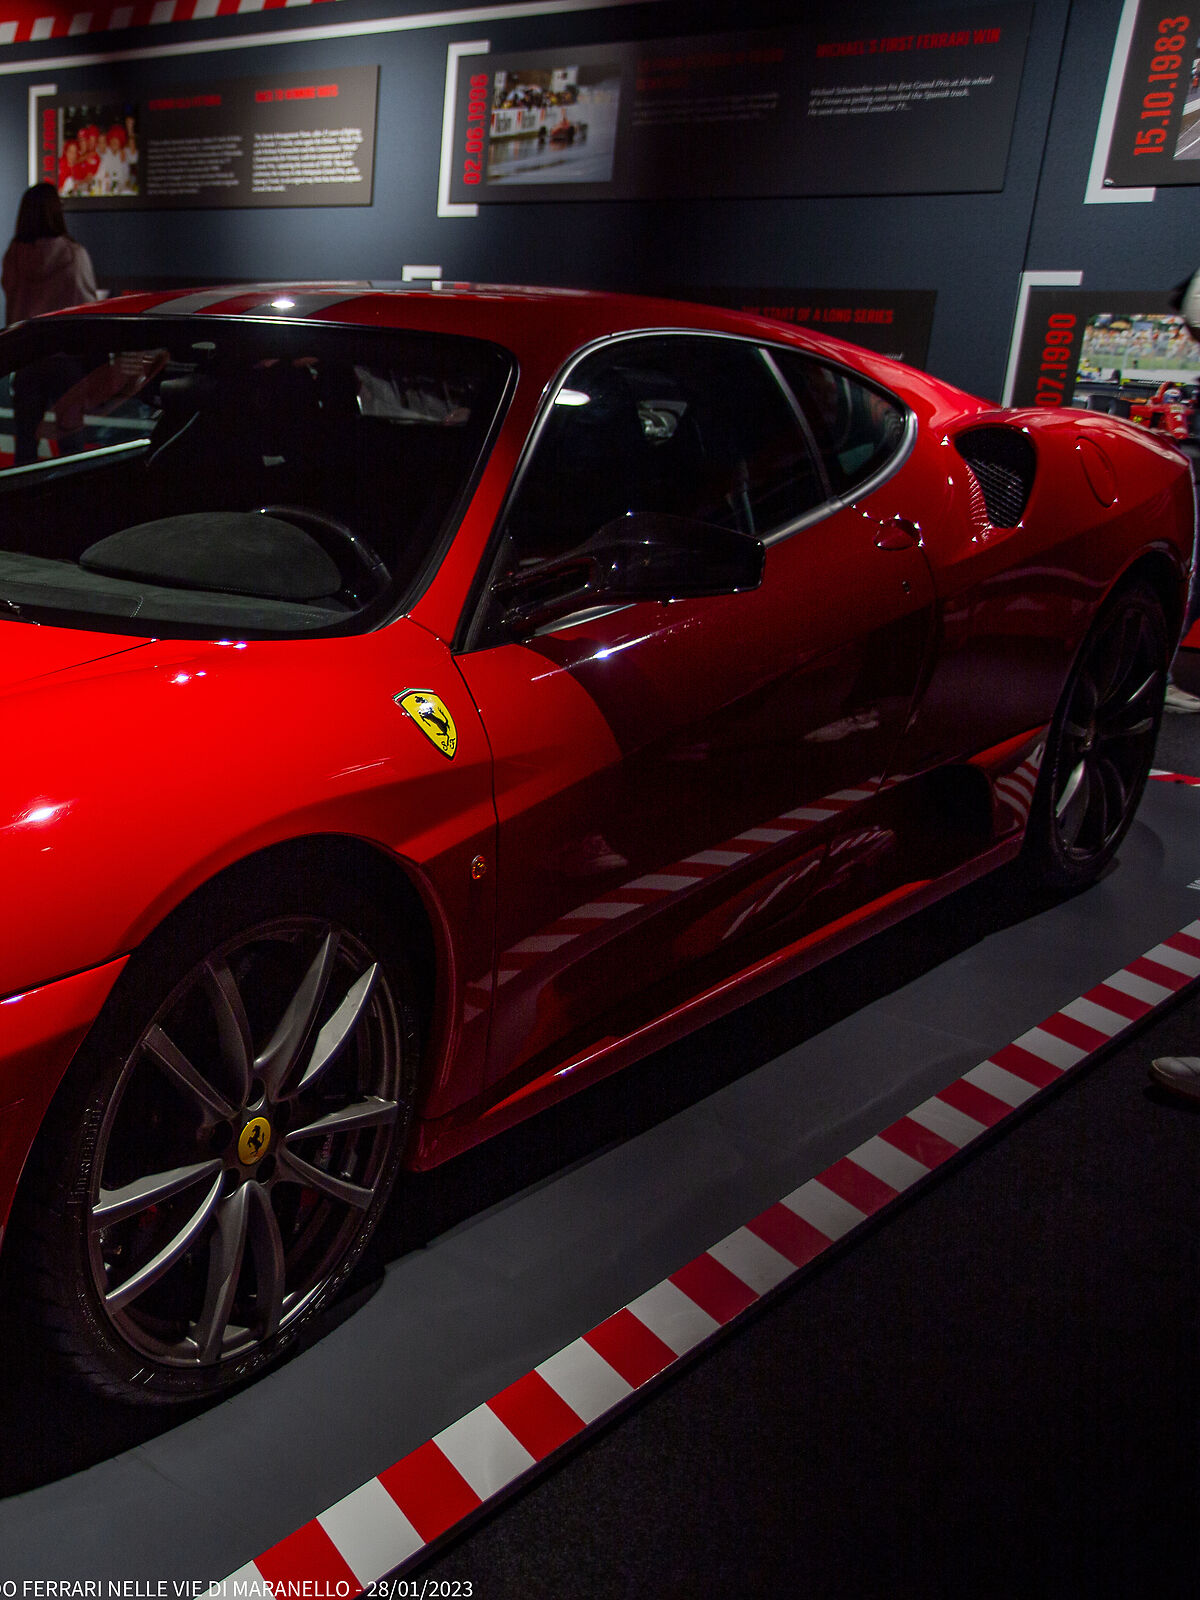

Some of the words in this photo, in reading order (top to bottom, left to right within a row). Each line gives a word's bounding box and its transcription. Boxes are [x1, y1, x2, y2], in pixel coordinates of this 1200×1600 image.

[879, 35, 914, 53] FIRST
[916, 31, 971, 49] FERRARI
[972, 27, 1001, 44] WIN
[1133, 15, 1190, 157] 15.10.1983
[463, 73, 489, 185] 02.06.1996
[854, 309, 894, 324] SERIES
